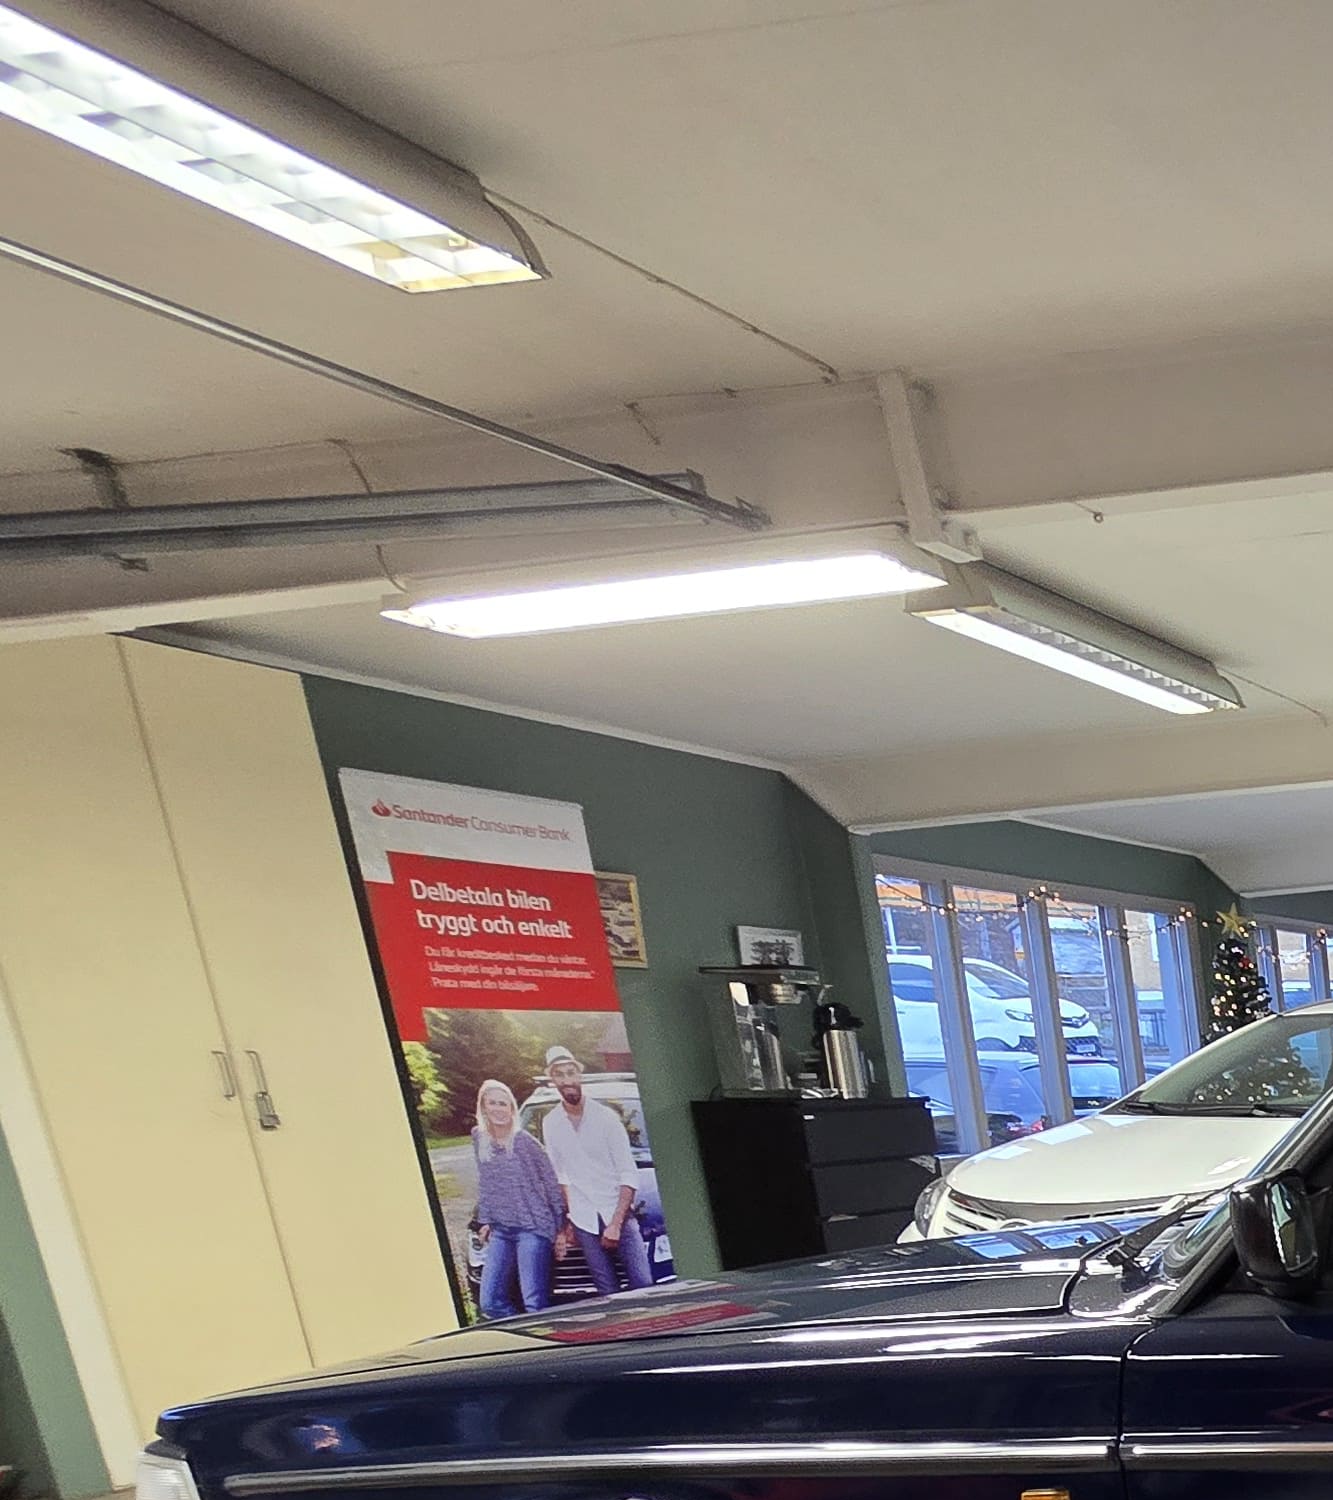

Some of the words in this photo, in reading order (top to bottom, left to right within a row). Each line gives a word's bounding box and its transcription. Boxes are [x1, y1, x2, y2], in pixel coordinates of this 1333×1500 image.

[392, 804, 469, 827] Santander
[471, 816, 537, 838] Consumer
[537, 824, 570, 841] Bank
[409, 878, 504, 907] Delbetala
[506, 889, 552, 911] bilen
[415, 909, 479, 937] tryggt
[481, 915, 515, 935] och
[518, 919, 574, 939] enkelt
